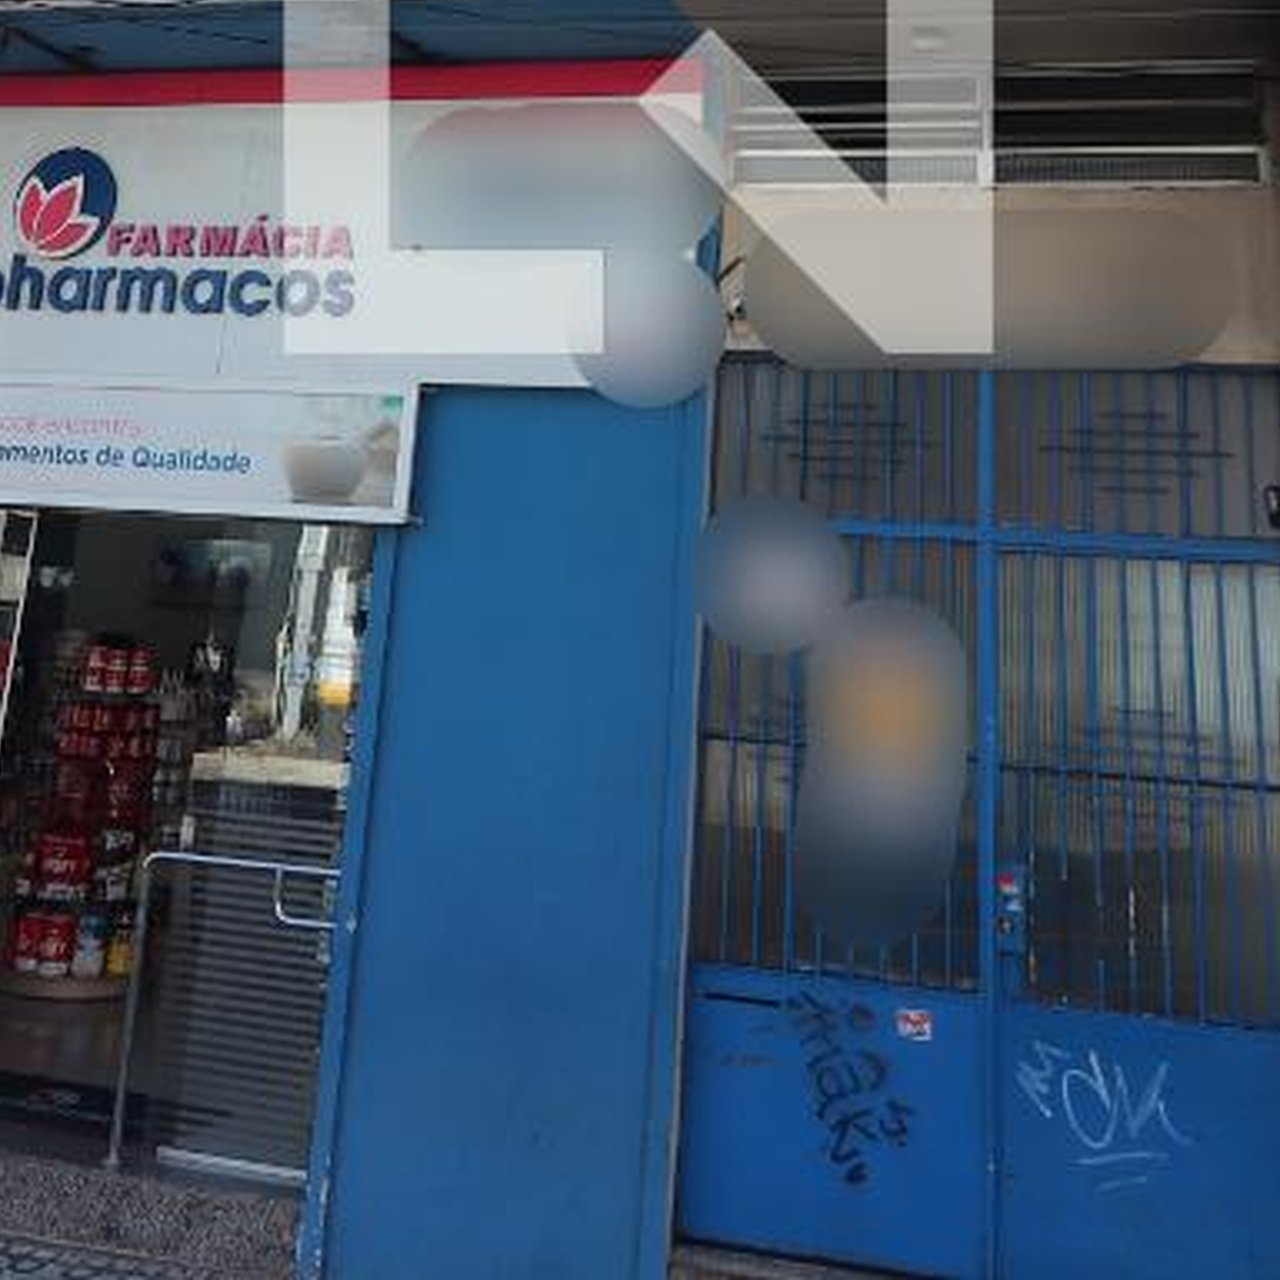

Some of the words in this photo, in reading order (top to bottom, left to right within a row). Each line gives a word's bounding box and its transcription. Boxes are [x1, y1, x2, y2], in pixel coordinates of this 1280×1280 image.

[105, 214, 355, 260] FARMÁCIA
[94, 442, 124, 469] de
[131, 445, 253, 475] Qualidade
